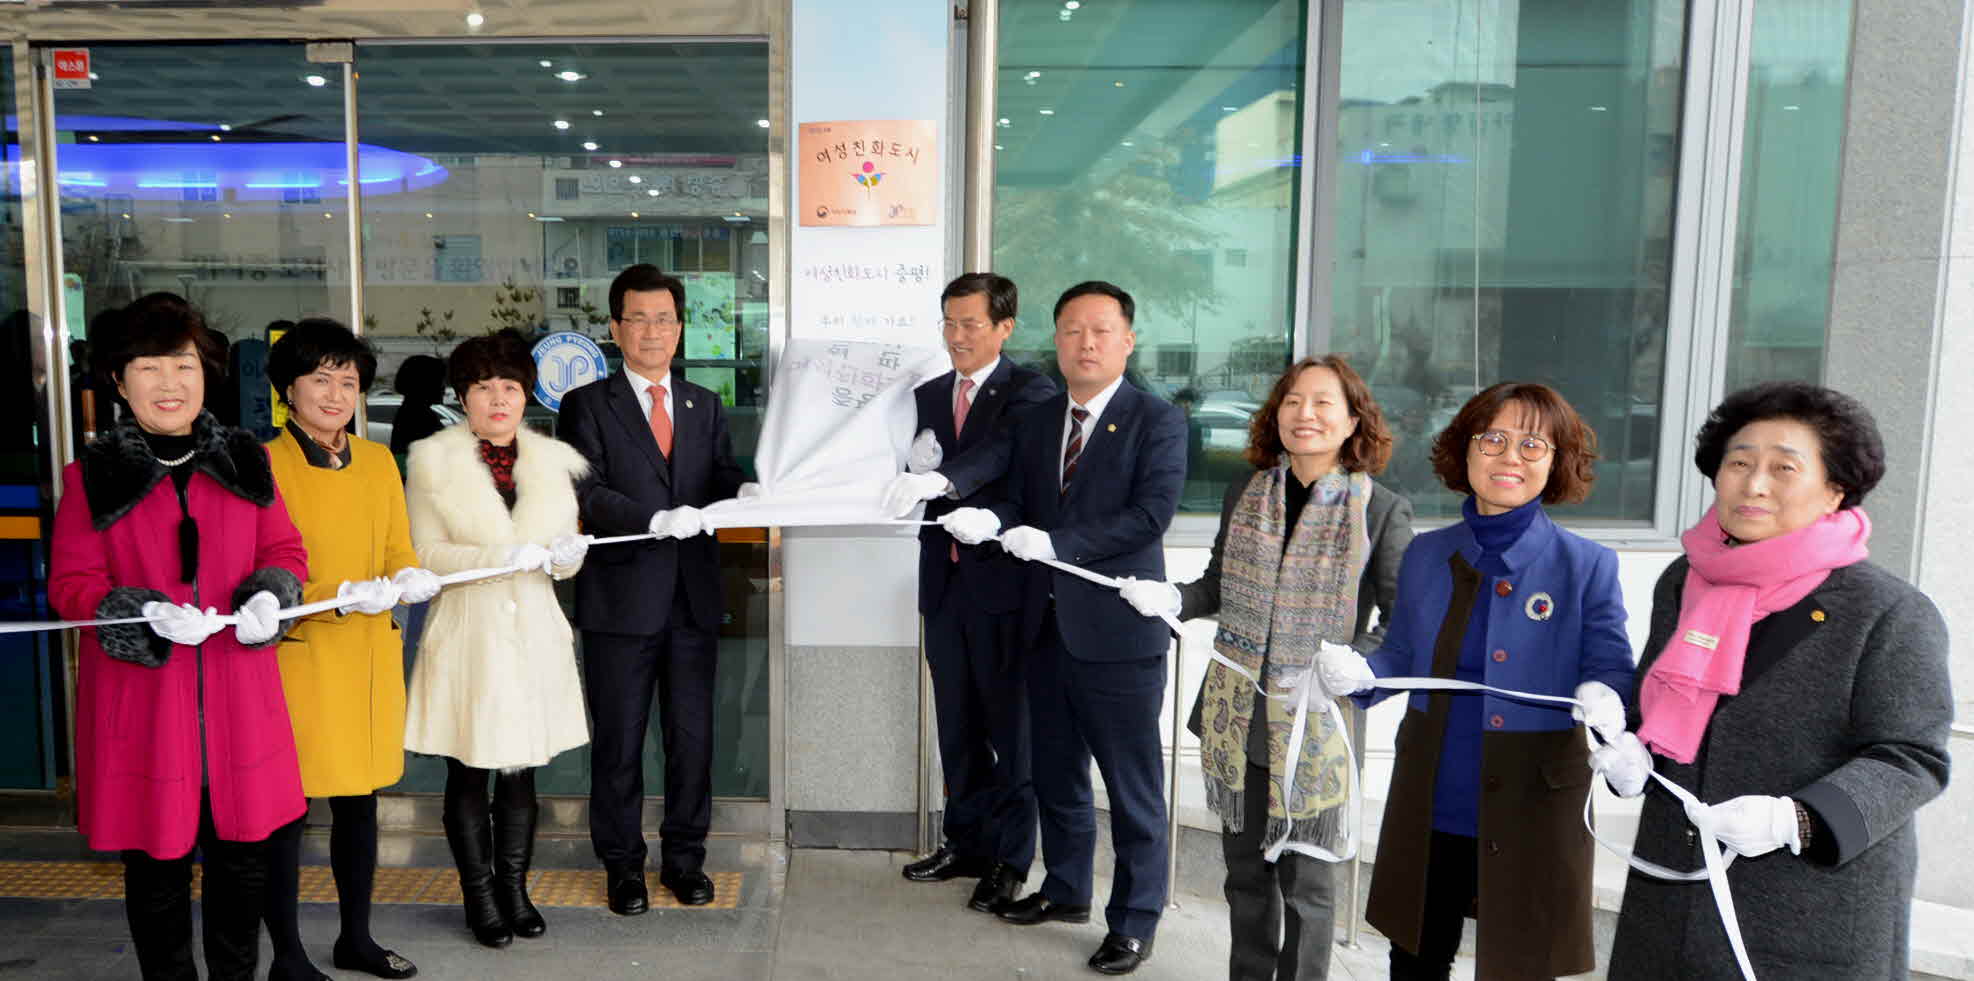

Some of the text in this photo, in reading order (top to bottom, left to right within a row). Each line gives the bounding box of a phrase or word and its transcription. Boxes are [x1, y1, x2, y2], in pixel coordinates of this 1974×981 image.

[815, 138, 920, 165] 여성친화도시
[803, 263, 929, 283] 여성친화도시 증평!
